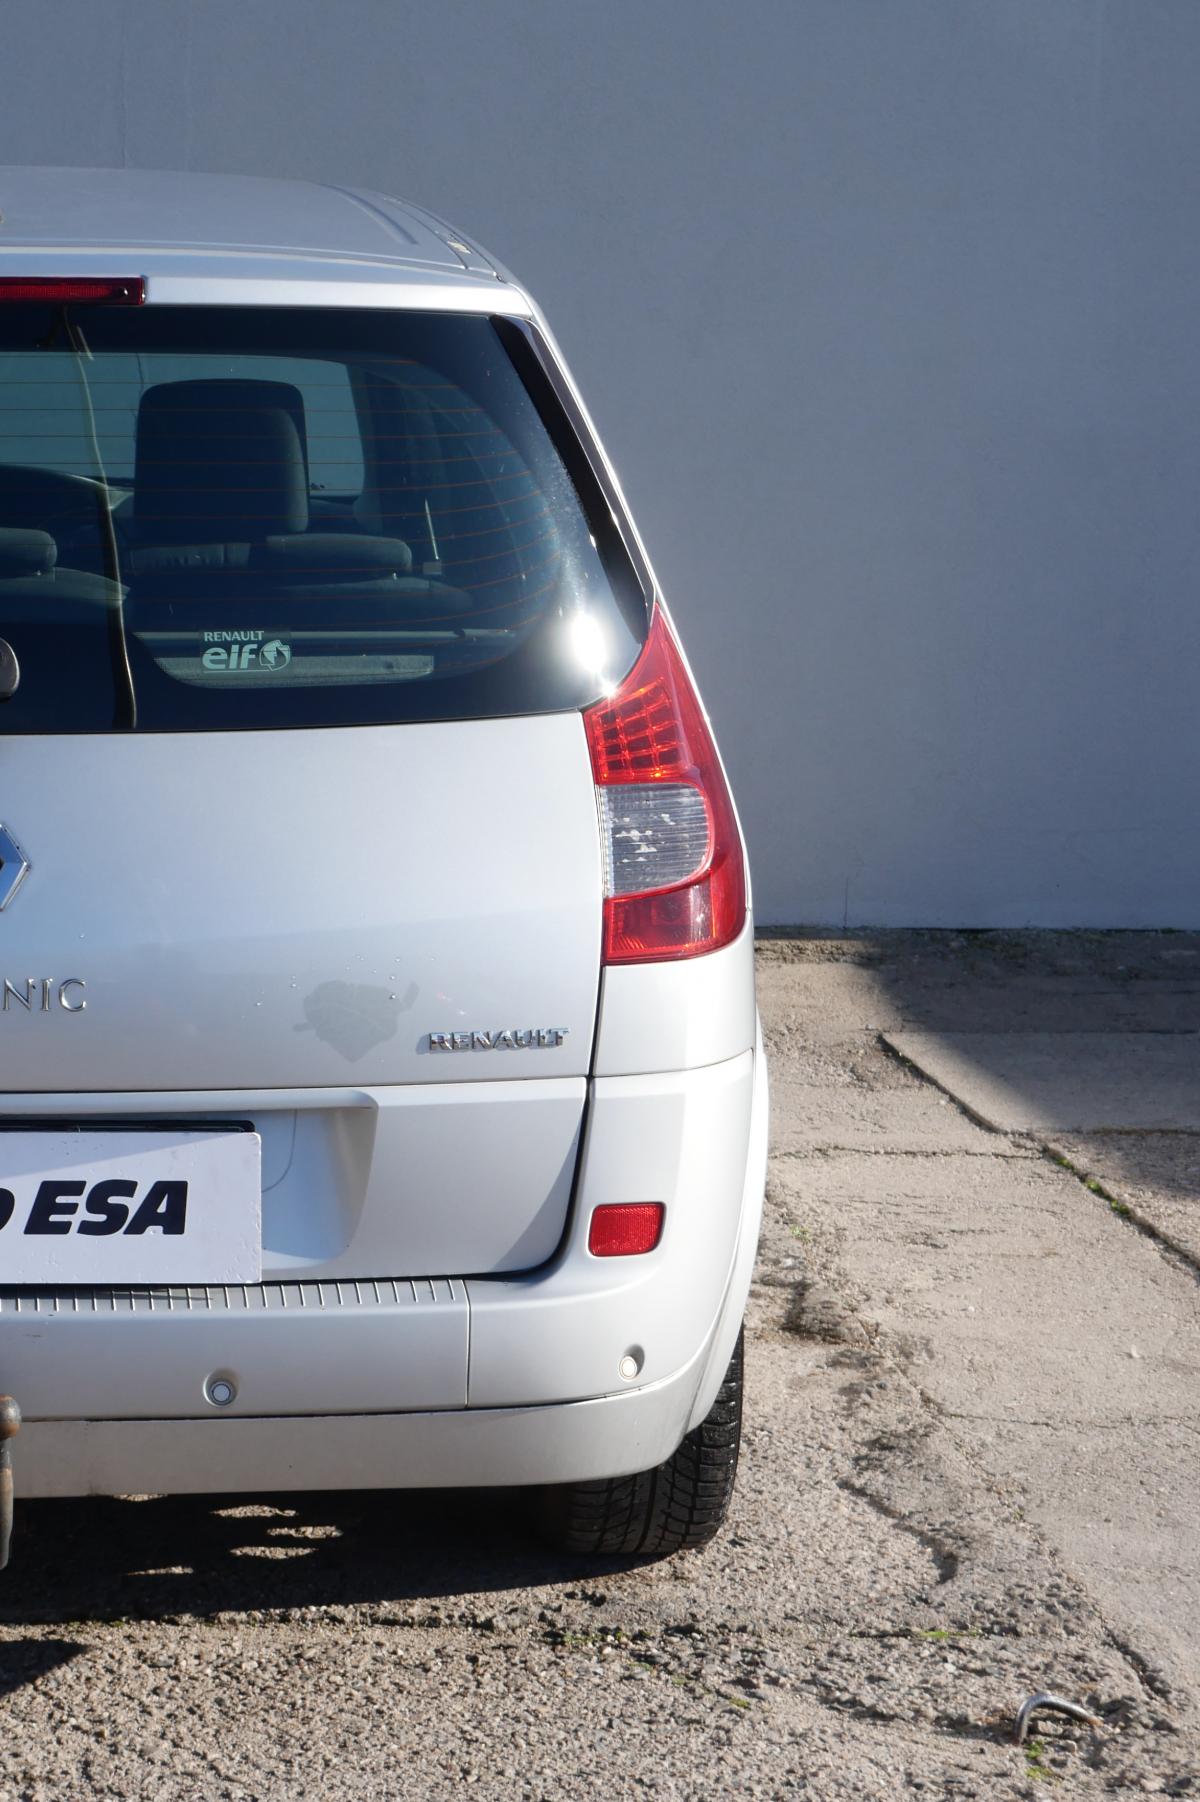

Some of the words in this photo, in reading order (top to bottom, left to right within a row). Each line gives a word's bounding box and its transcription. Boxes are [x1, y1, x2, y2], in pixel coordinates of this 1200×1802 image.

[204, 630, 265, 642] RENAULT
[202, 644, 259, 670] elf
[428, 1028, 569, 1052] RENAULT
[24, 1178, 188, 1236] ESA
